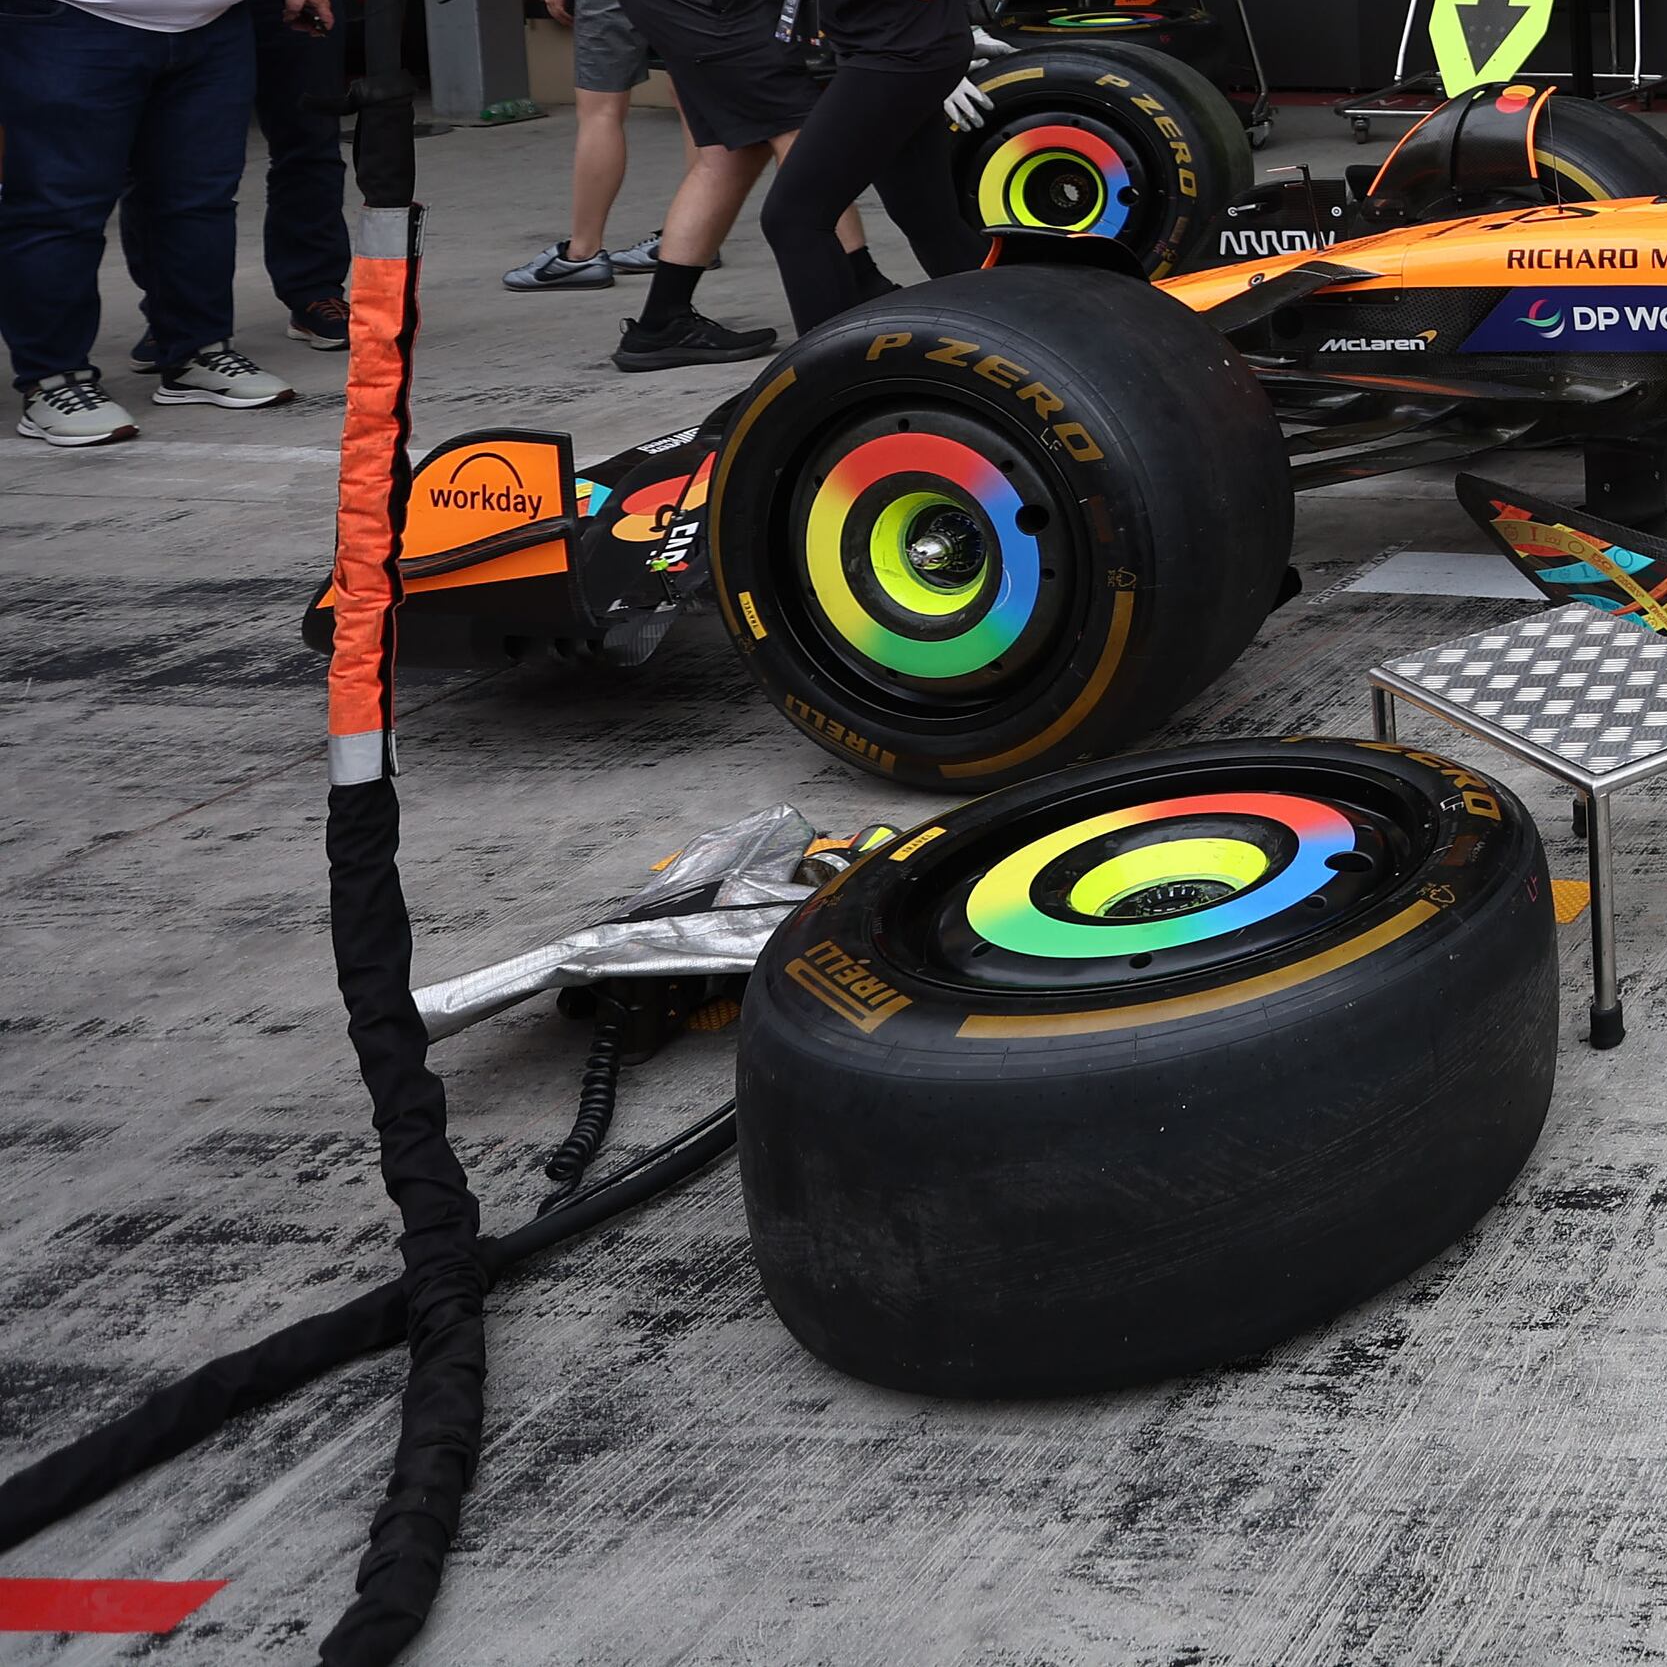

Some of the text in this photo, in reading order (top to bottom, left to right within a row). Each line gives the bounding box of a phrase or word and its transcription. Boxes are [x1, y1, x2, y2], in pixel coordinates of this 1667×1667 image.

[1095, 74, 1197, 198] P ZERO
[1507, 248, 1637, 270] RICHARD
[1319, 338, 1425, 352] McLaren
[1573, 306, 1621, 332] DP
[865, 332, 1105, 462] P ZERO
[430, 484, 542, 520] workday
[784, 694, 896, 773] PIRELLI
[784, 939, 913, 1034] PIRELLI
